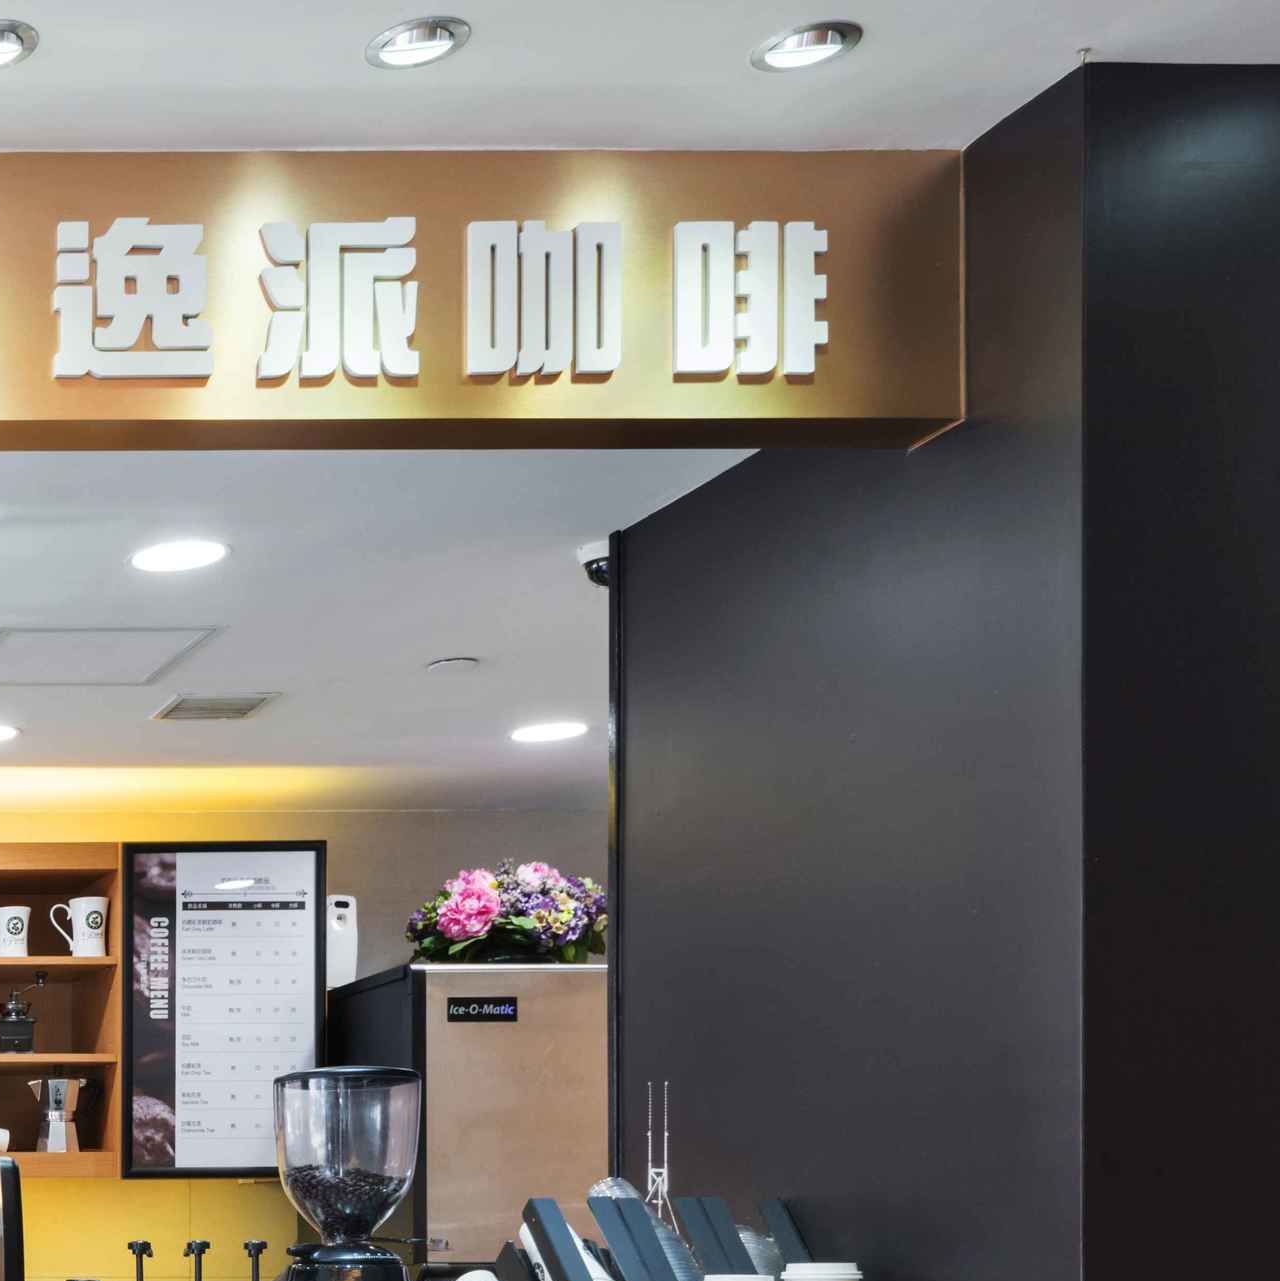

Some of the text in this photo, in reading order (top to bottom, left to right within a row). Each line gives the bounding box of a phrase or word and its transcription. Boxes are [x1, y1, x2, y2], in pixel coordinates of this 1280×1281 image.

[51, 216, 828, 380] 逸派咖啡
[150, 917, 169, 1019] COFFEE MENU
[449, 1003, 515, 1015] Ice-O-Matic
